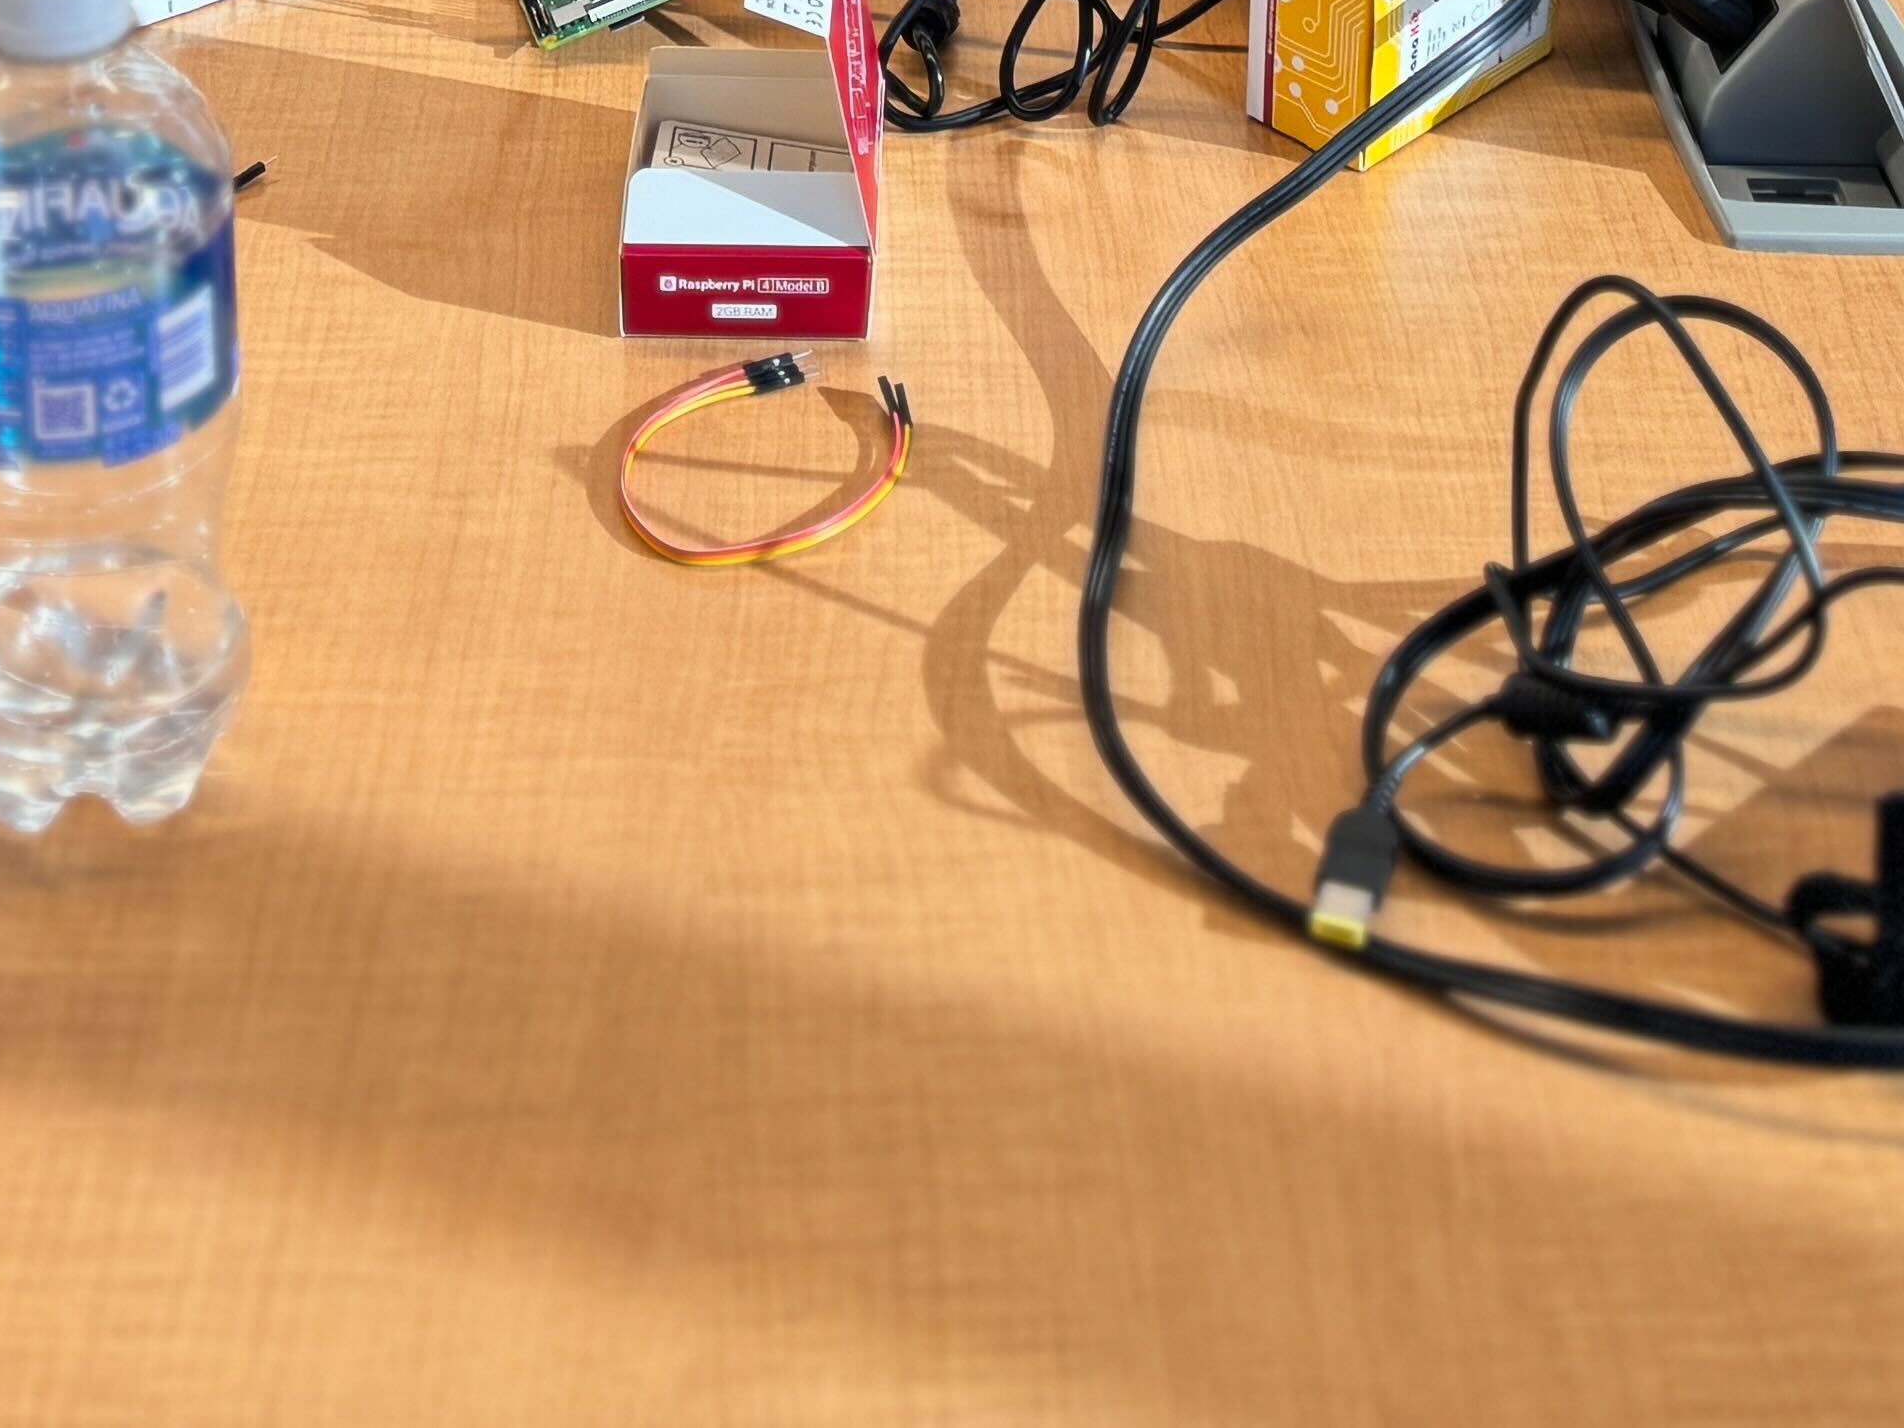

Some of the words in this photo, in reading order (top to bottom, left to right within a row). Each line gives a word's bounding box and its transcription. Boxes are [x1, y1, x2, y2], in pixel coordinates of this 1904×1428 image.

[678, 278, 740, 293] Raspberry
[742, 278, 755, 292] Pi
[761, 280, 772, 291] 4
[775, 280, 813, 292] Model
[29, 286, 143, 325] AQUAFINA
[743, 306, 773, 317] RAM
